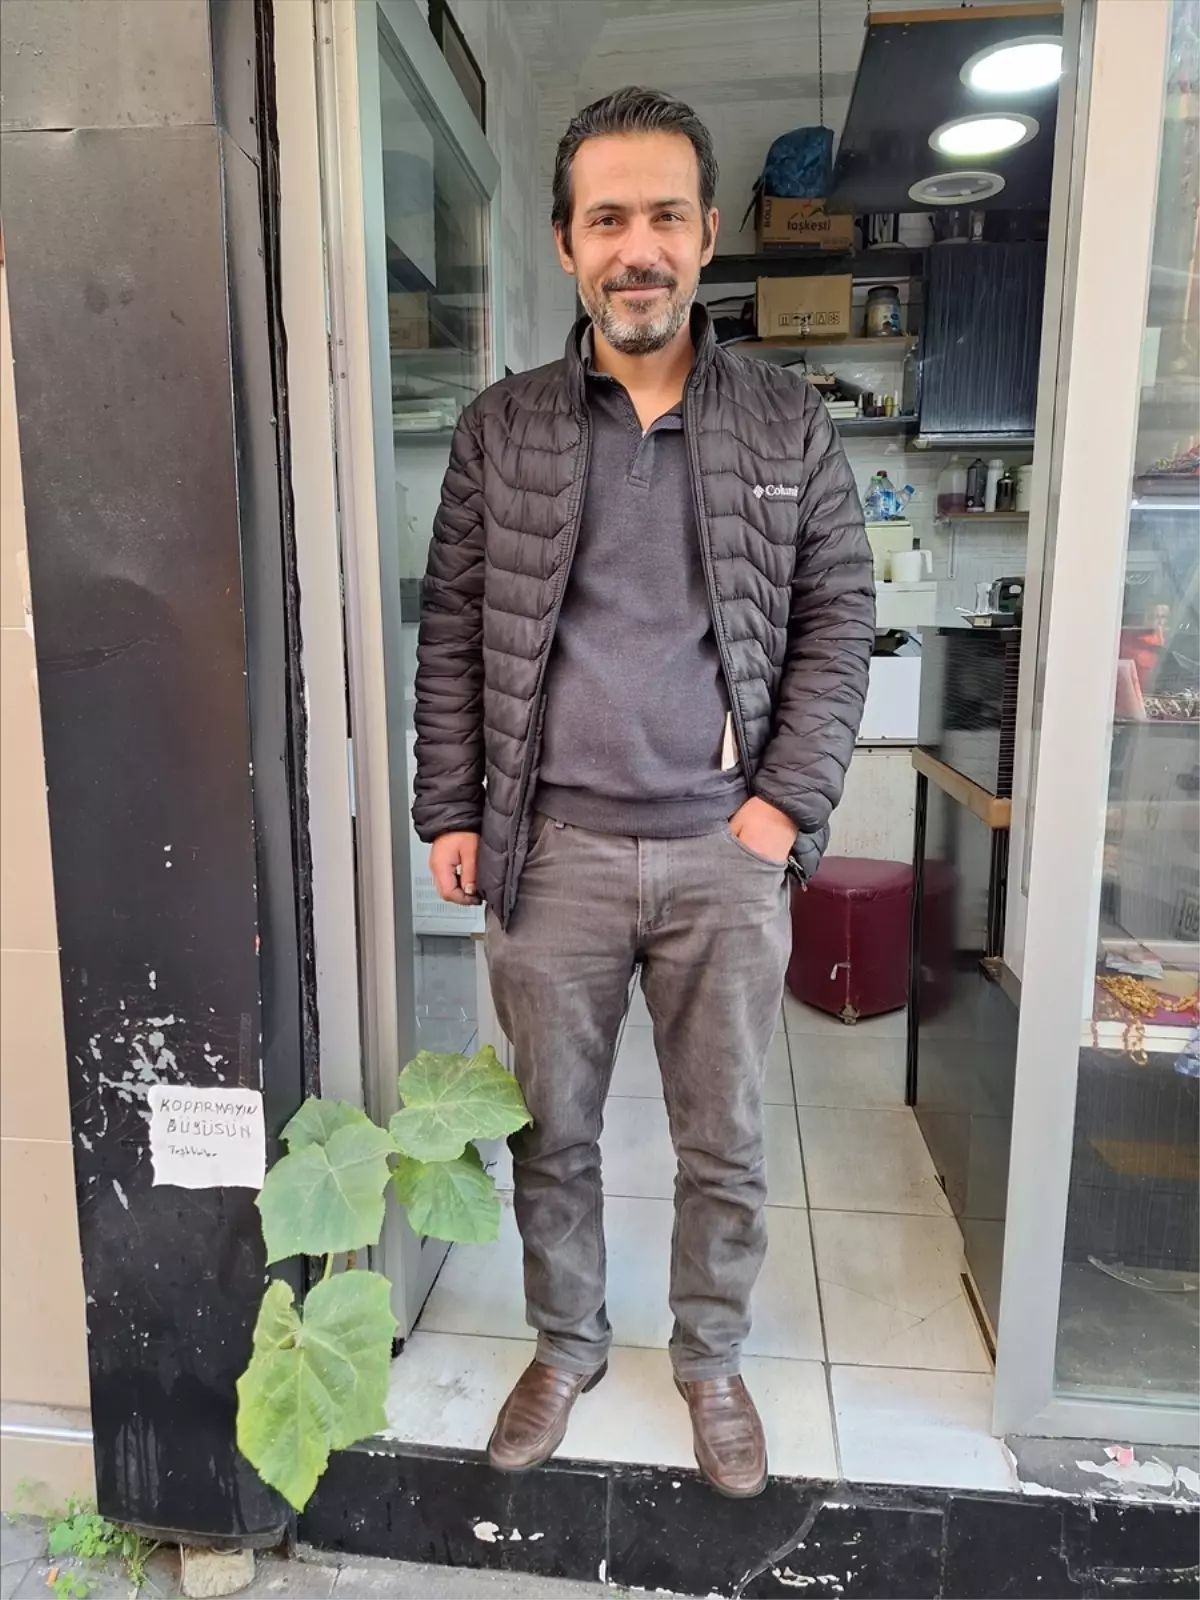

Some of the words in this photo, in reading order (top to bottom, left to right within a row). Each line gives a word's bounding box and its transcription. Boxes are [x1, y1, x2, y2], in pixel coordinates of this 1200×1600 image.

[763, 199, 773, 228] BOLU
[160, 1099, 258, 1116] KOPARMAYIN
[167, 1116, 252, 1138] BÜYÜSÜN
